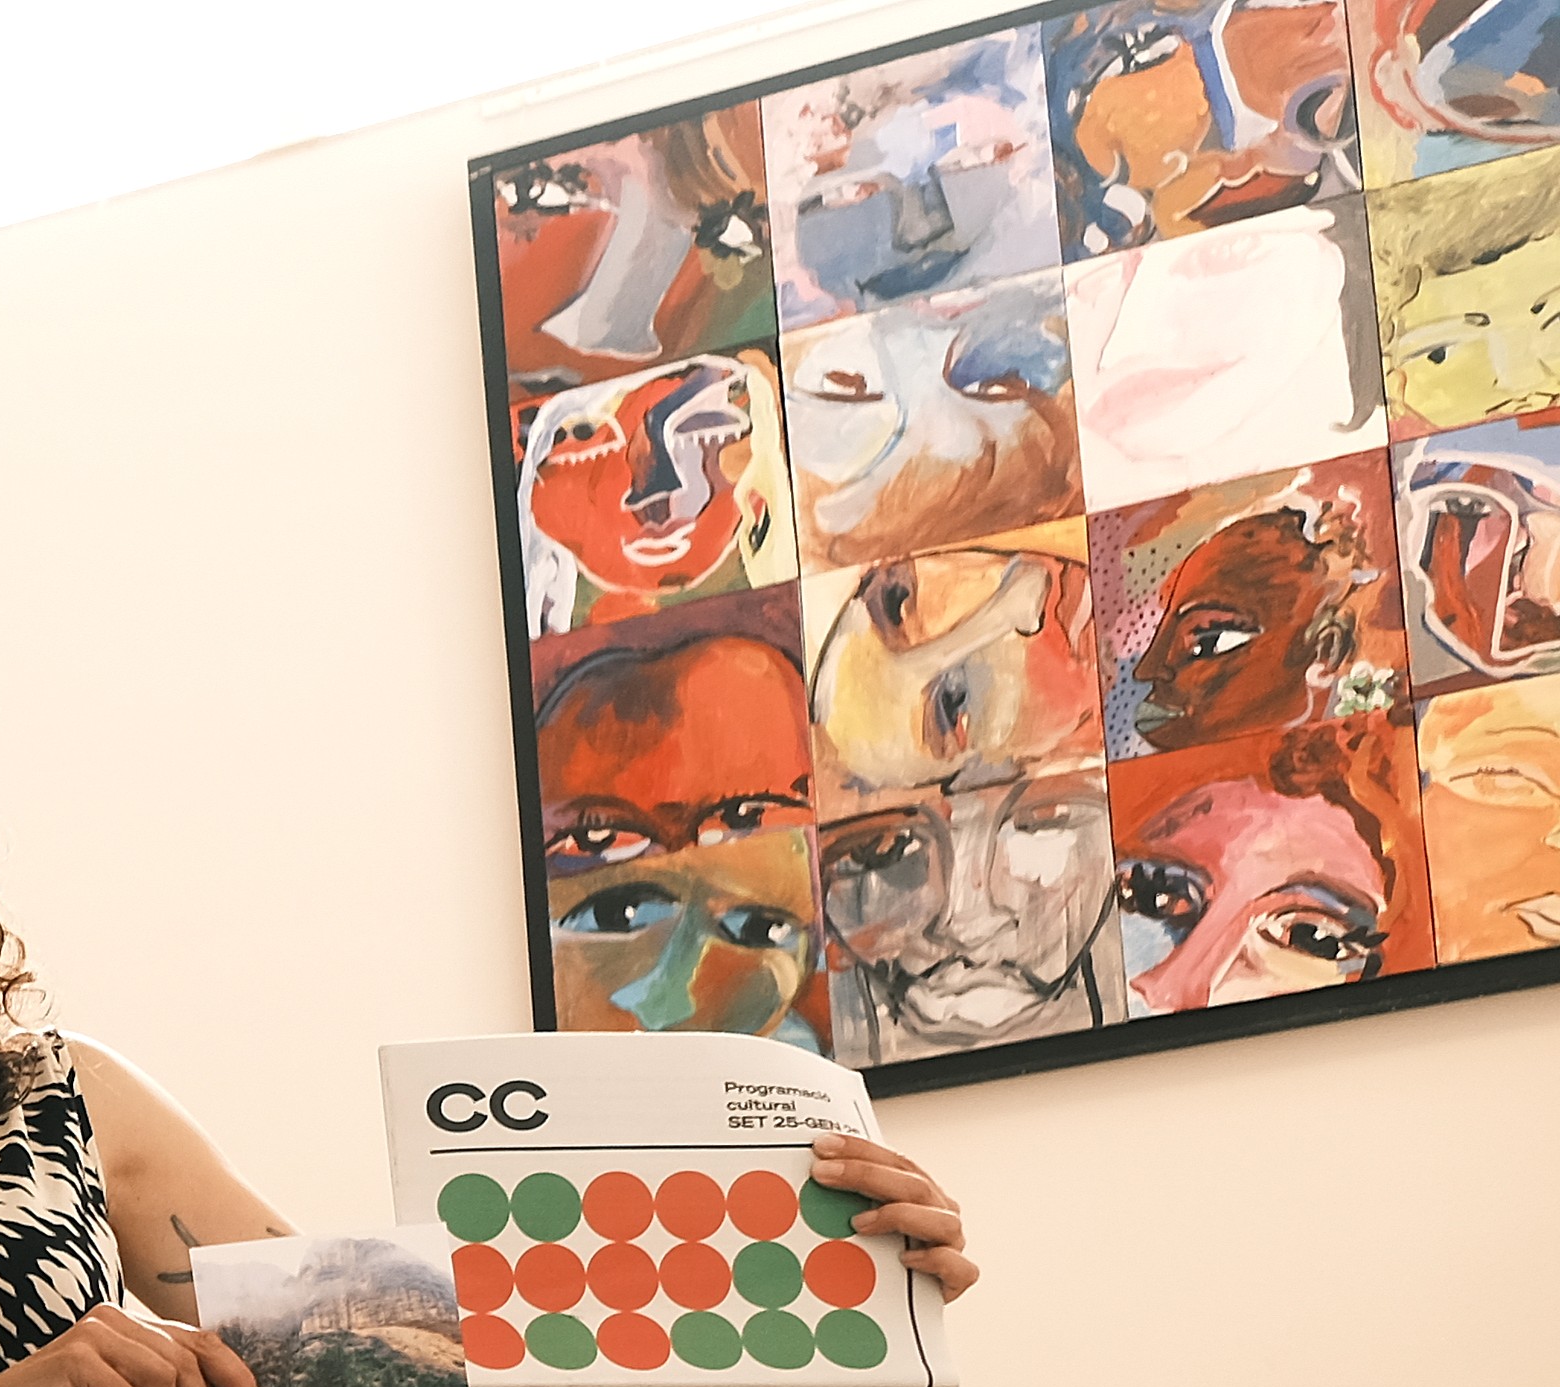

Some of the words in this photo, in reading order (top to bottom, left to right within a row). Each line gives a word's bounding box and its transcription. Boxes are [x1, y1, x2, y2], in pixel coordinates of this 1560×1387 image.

[426, 1080, 549, 1132] CC
[726, 1100, 796, 1111] cultural
[728, 1116, 768, 1128] SET
